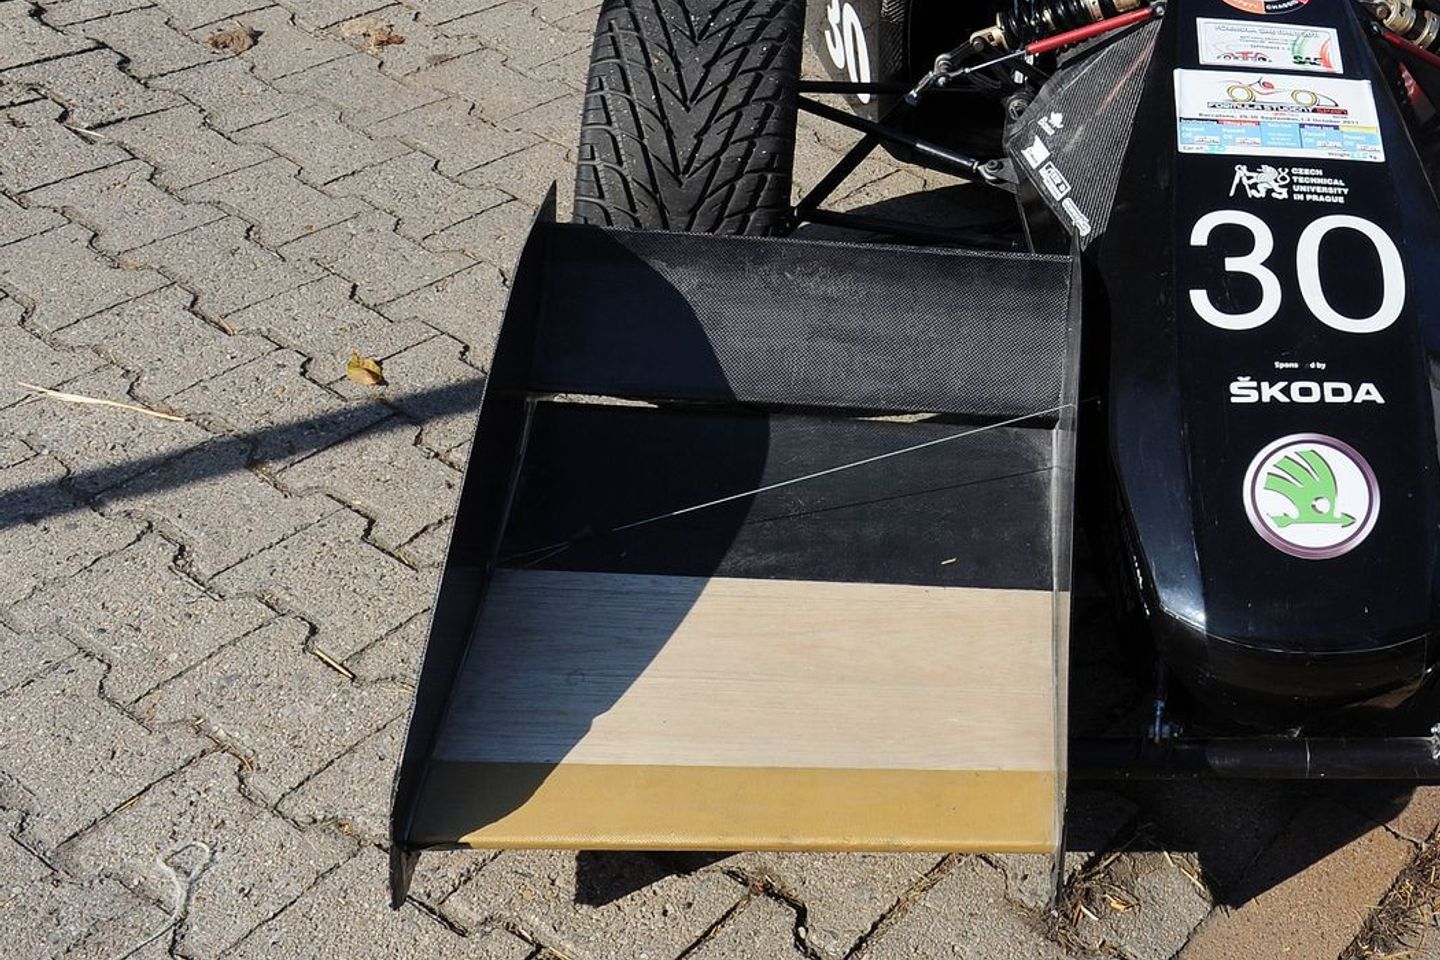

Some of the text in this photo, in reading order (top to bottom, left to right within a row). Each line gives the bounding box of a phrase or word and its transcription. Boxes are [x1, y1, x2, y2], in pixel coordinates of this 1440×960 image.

[1291, 167, 1323, 176] CZECH
[1291, 175, 1346, 186] TECHNICAL
[1292, 184, 1349, 195] UNIVERSITY
[1293, 193, 1345, 204] IN PRAGUE
[1188, 209, 1406, 334] 30
[1316, 361, 1326, 370] by
[1229, 376, 1385, 404] ŠKODA
